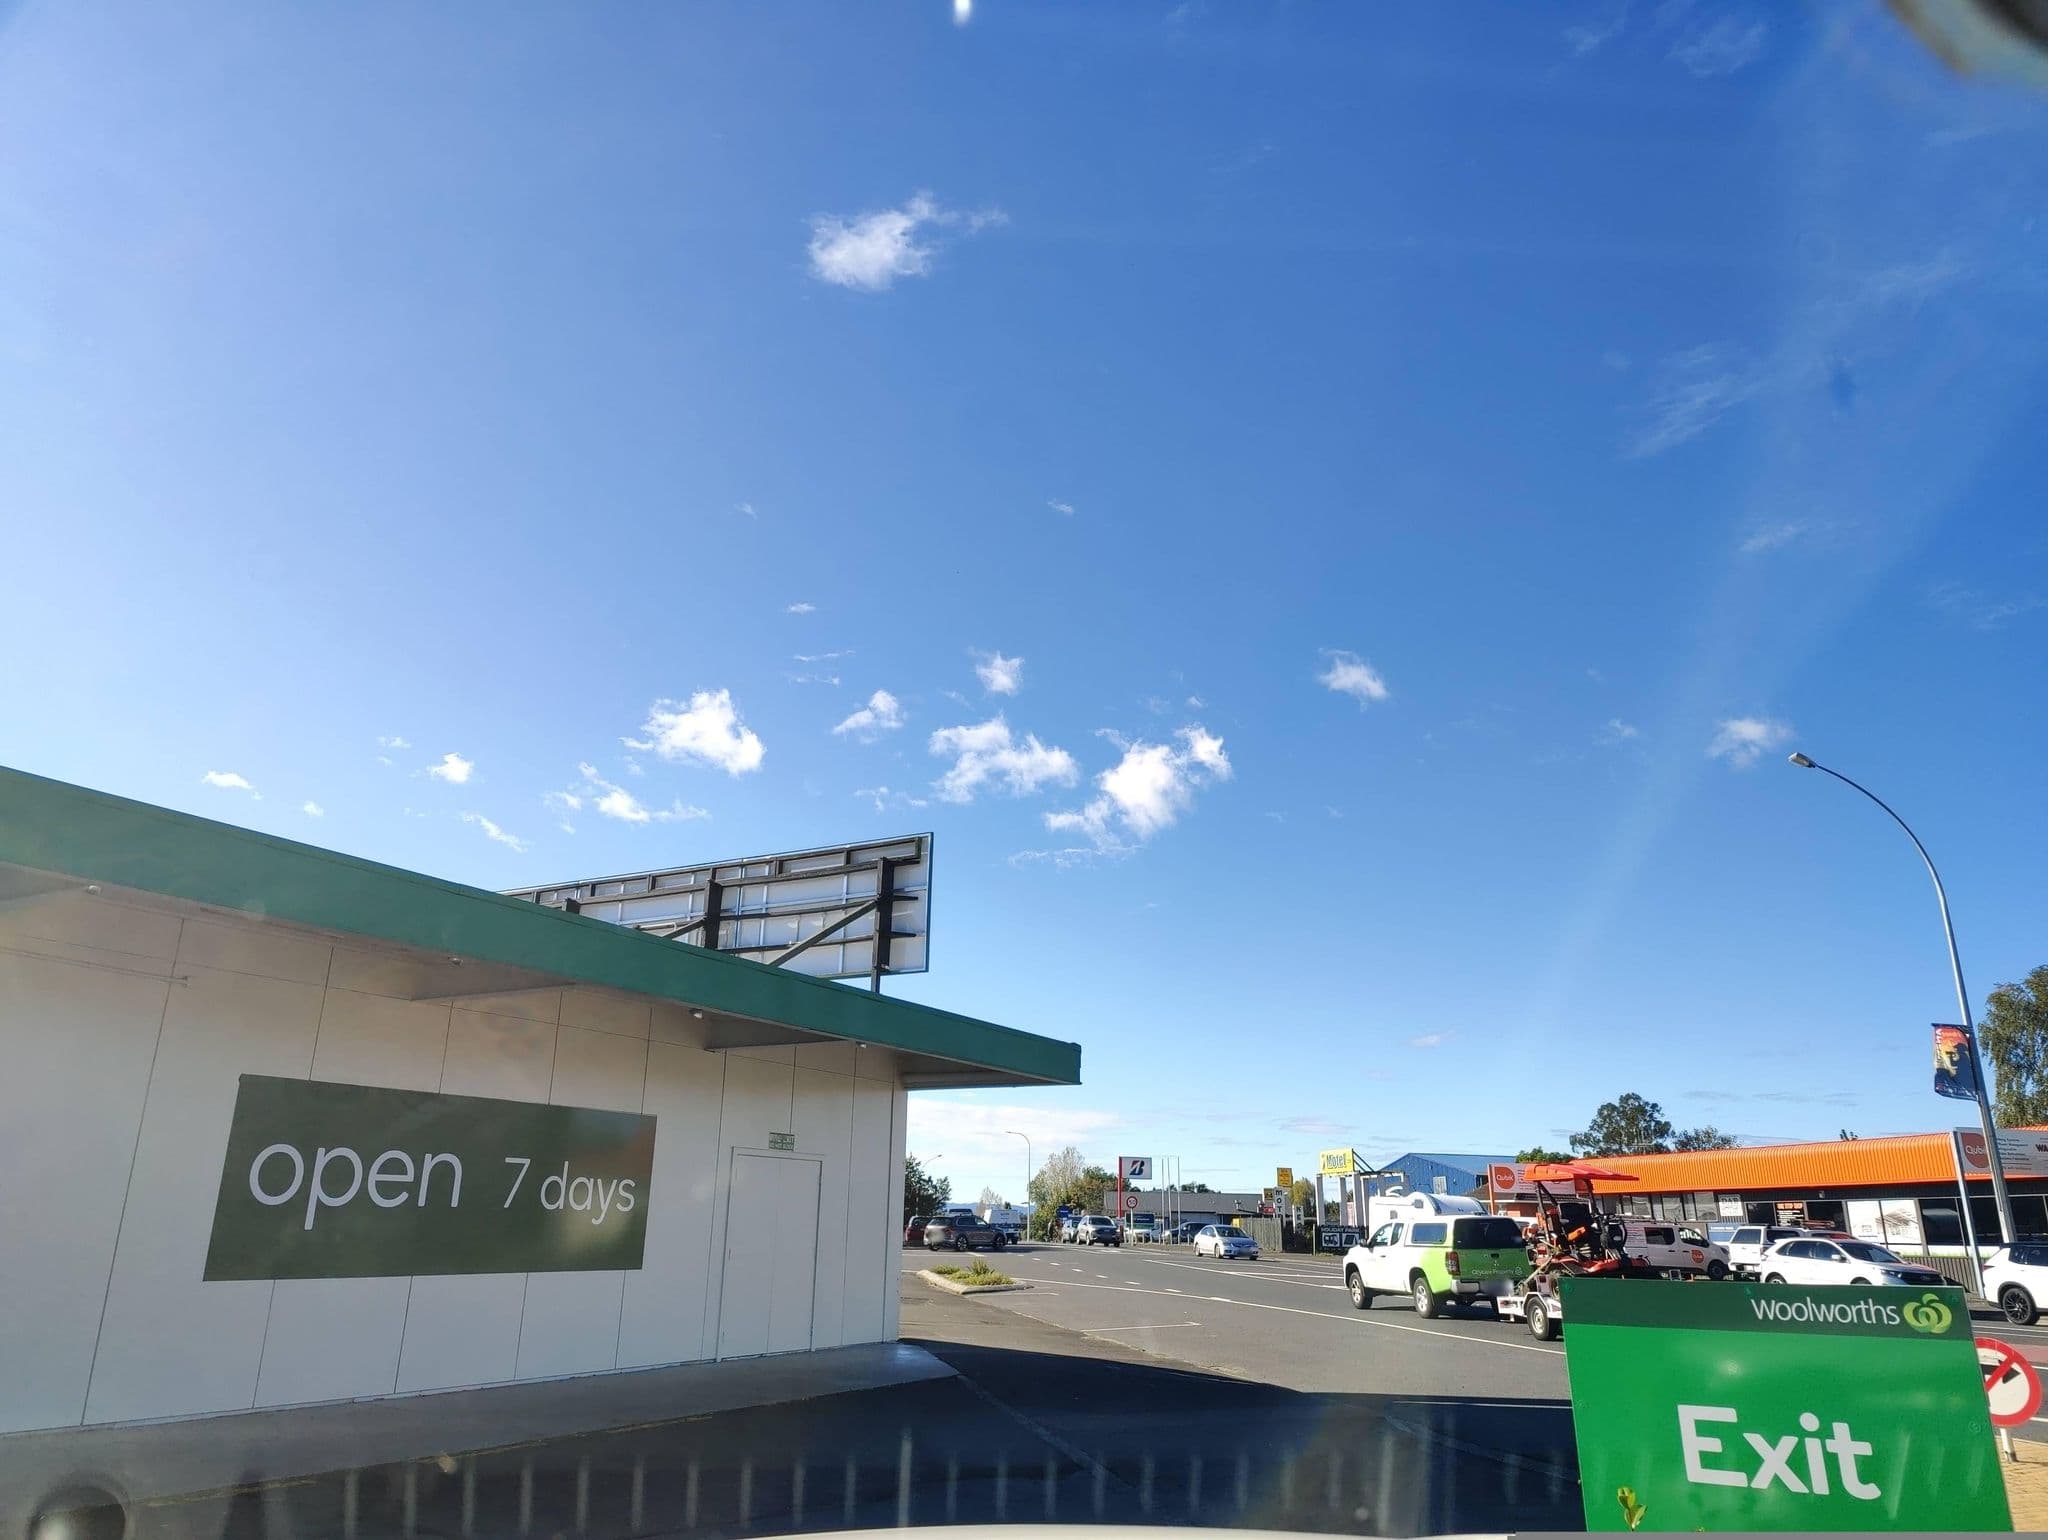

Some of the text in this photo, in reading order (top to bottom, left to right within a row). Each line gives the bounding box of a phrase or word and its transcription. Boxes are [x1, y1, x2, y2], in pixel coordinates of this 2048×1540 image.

[1326, 1152, 1346, 1170] Motel
[1965, 1145, 1985, 1156] Qub
[249, 1143, 636, 1231] open 7 days
[1750, 1295, 1900, 1327] Woolworths
[1677, 1404, 1882, 1501] Exit
